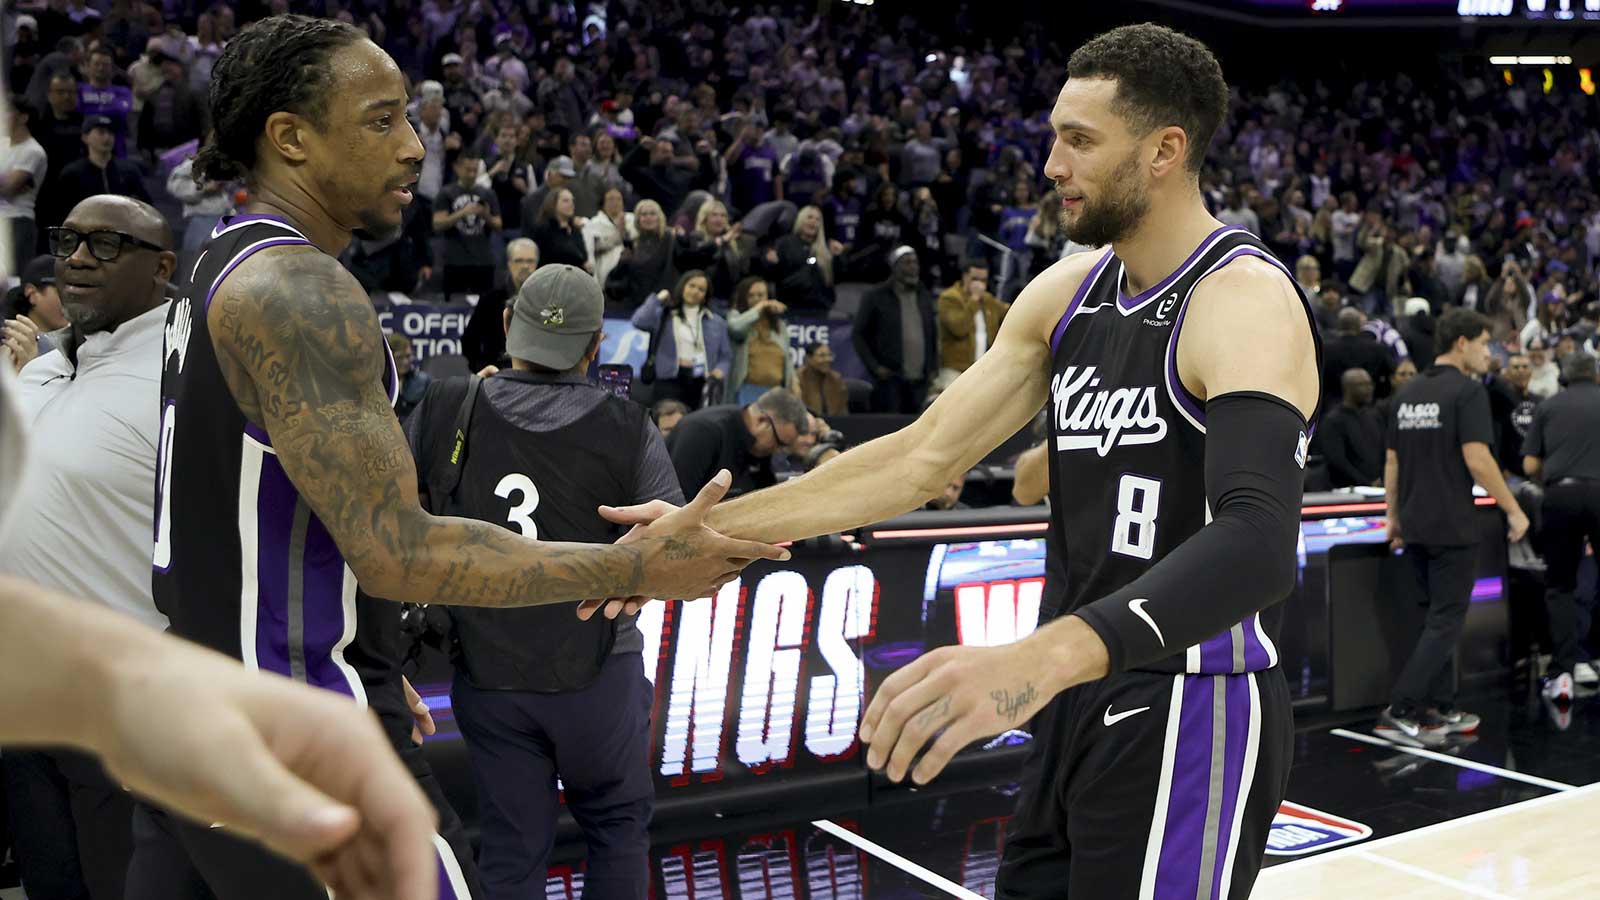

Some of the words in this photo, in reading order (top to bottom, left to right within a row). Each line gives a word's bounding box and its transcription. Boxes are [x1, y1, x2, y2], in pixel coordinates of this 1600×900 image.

[402, 312, 472, 336] OFFI
[1051, 366, 1168, 457] Kings
[493, 472, 540, 541] 3
[1111, 473, 1161, 561] 8
[989, 681, 1040, 723] Elijah
